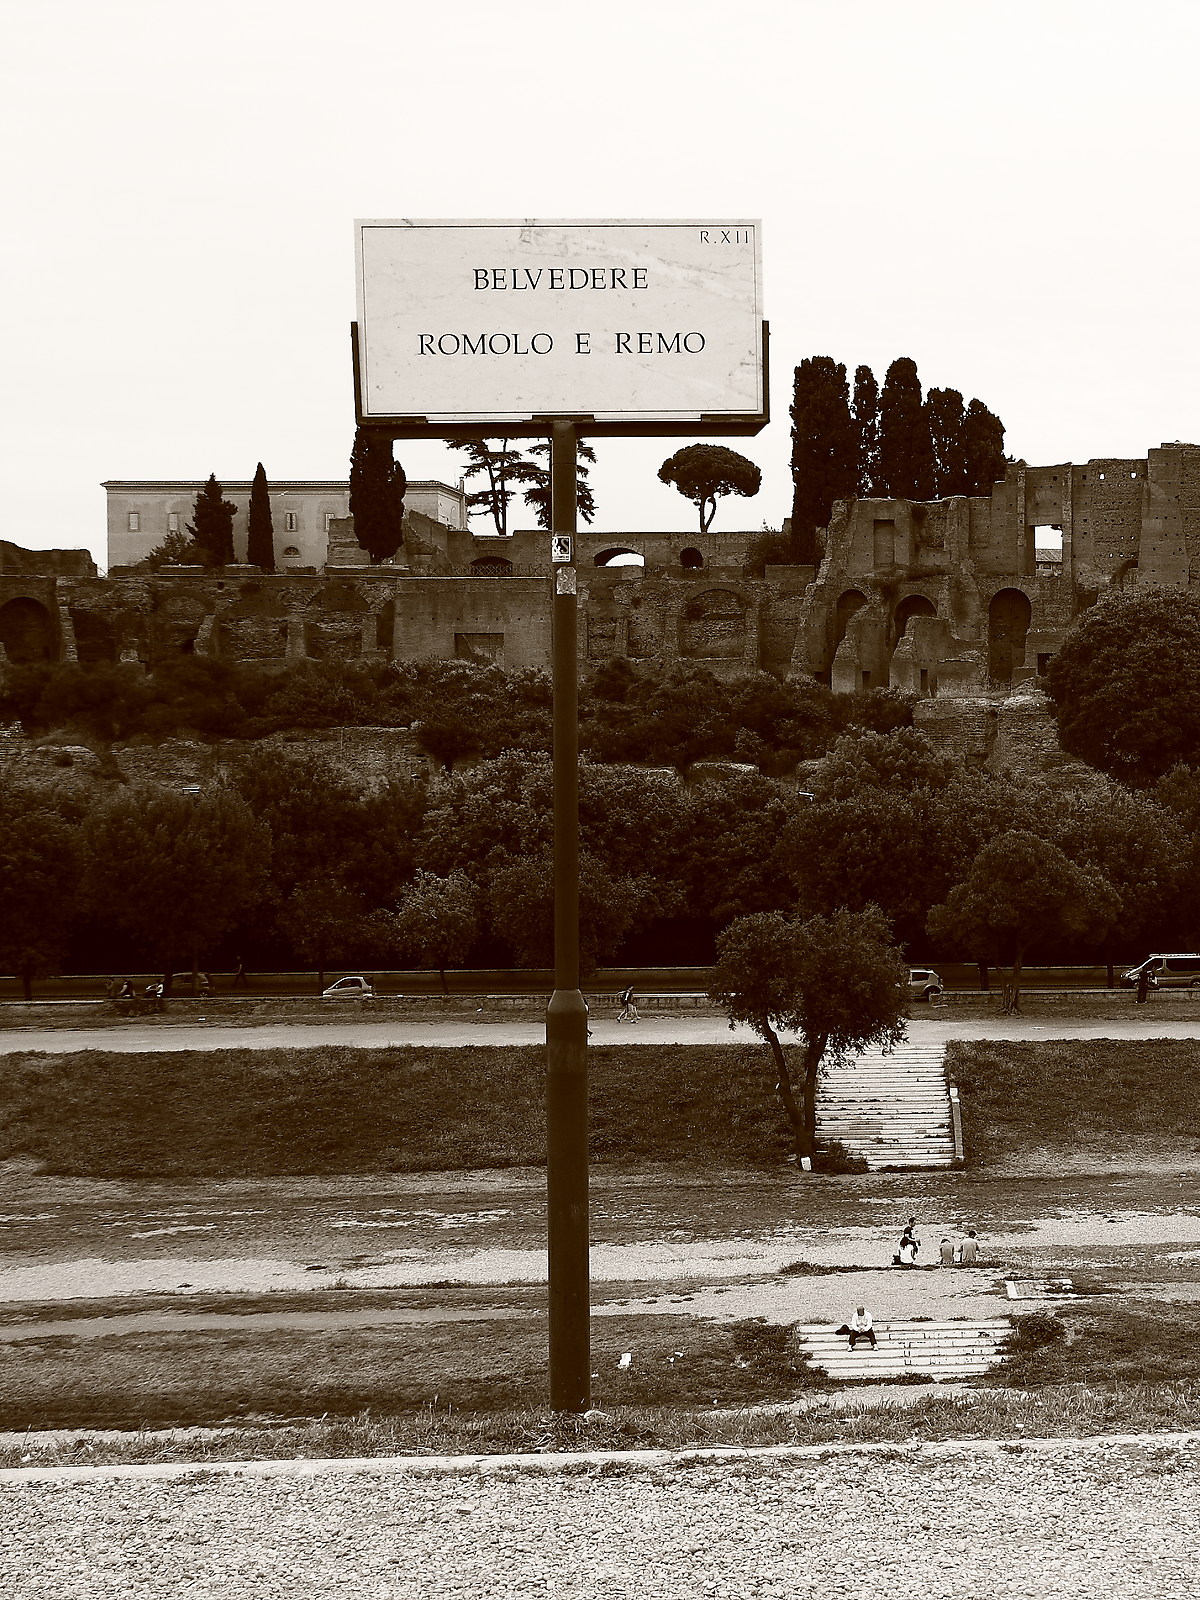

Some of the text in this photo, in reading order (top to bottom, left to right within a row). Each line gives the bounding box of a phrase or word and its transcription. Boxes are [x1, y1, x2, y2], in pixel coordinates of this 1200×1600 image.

[700, 230, 749, 244] R.XII
[473, 267, 649, 290] BELVEDERE
[418, 332, 706, 355] ROMOLO E REMO
